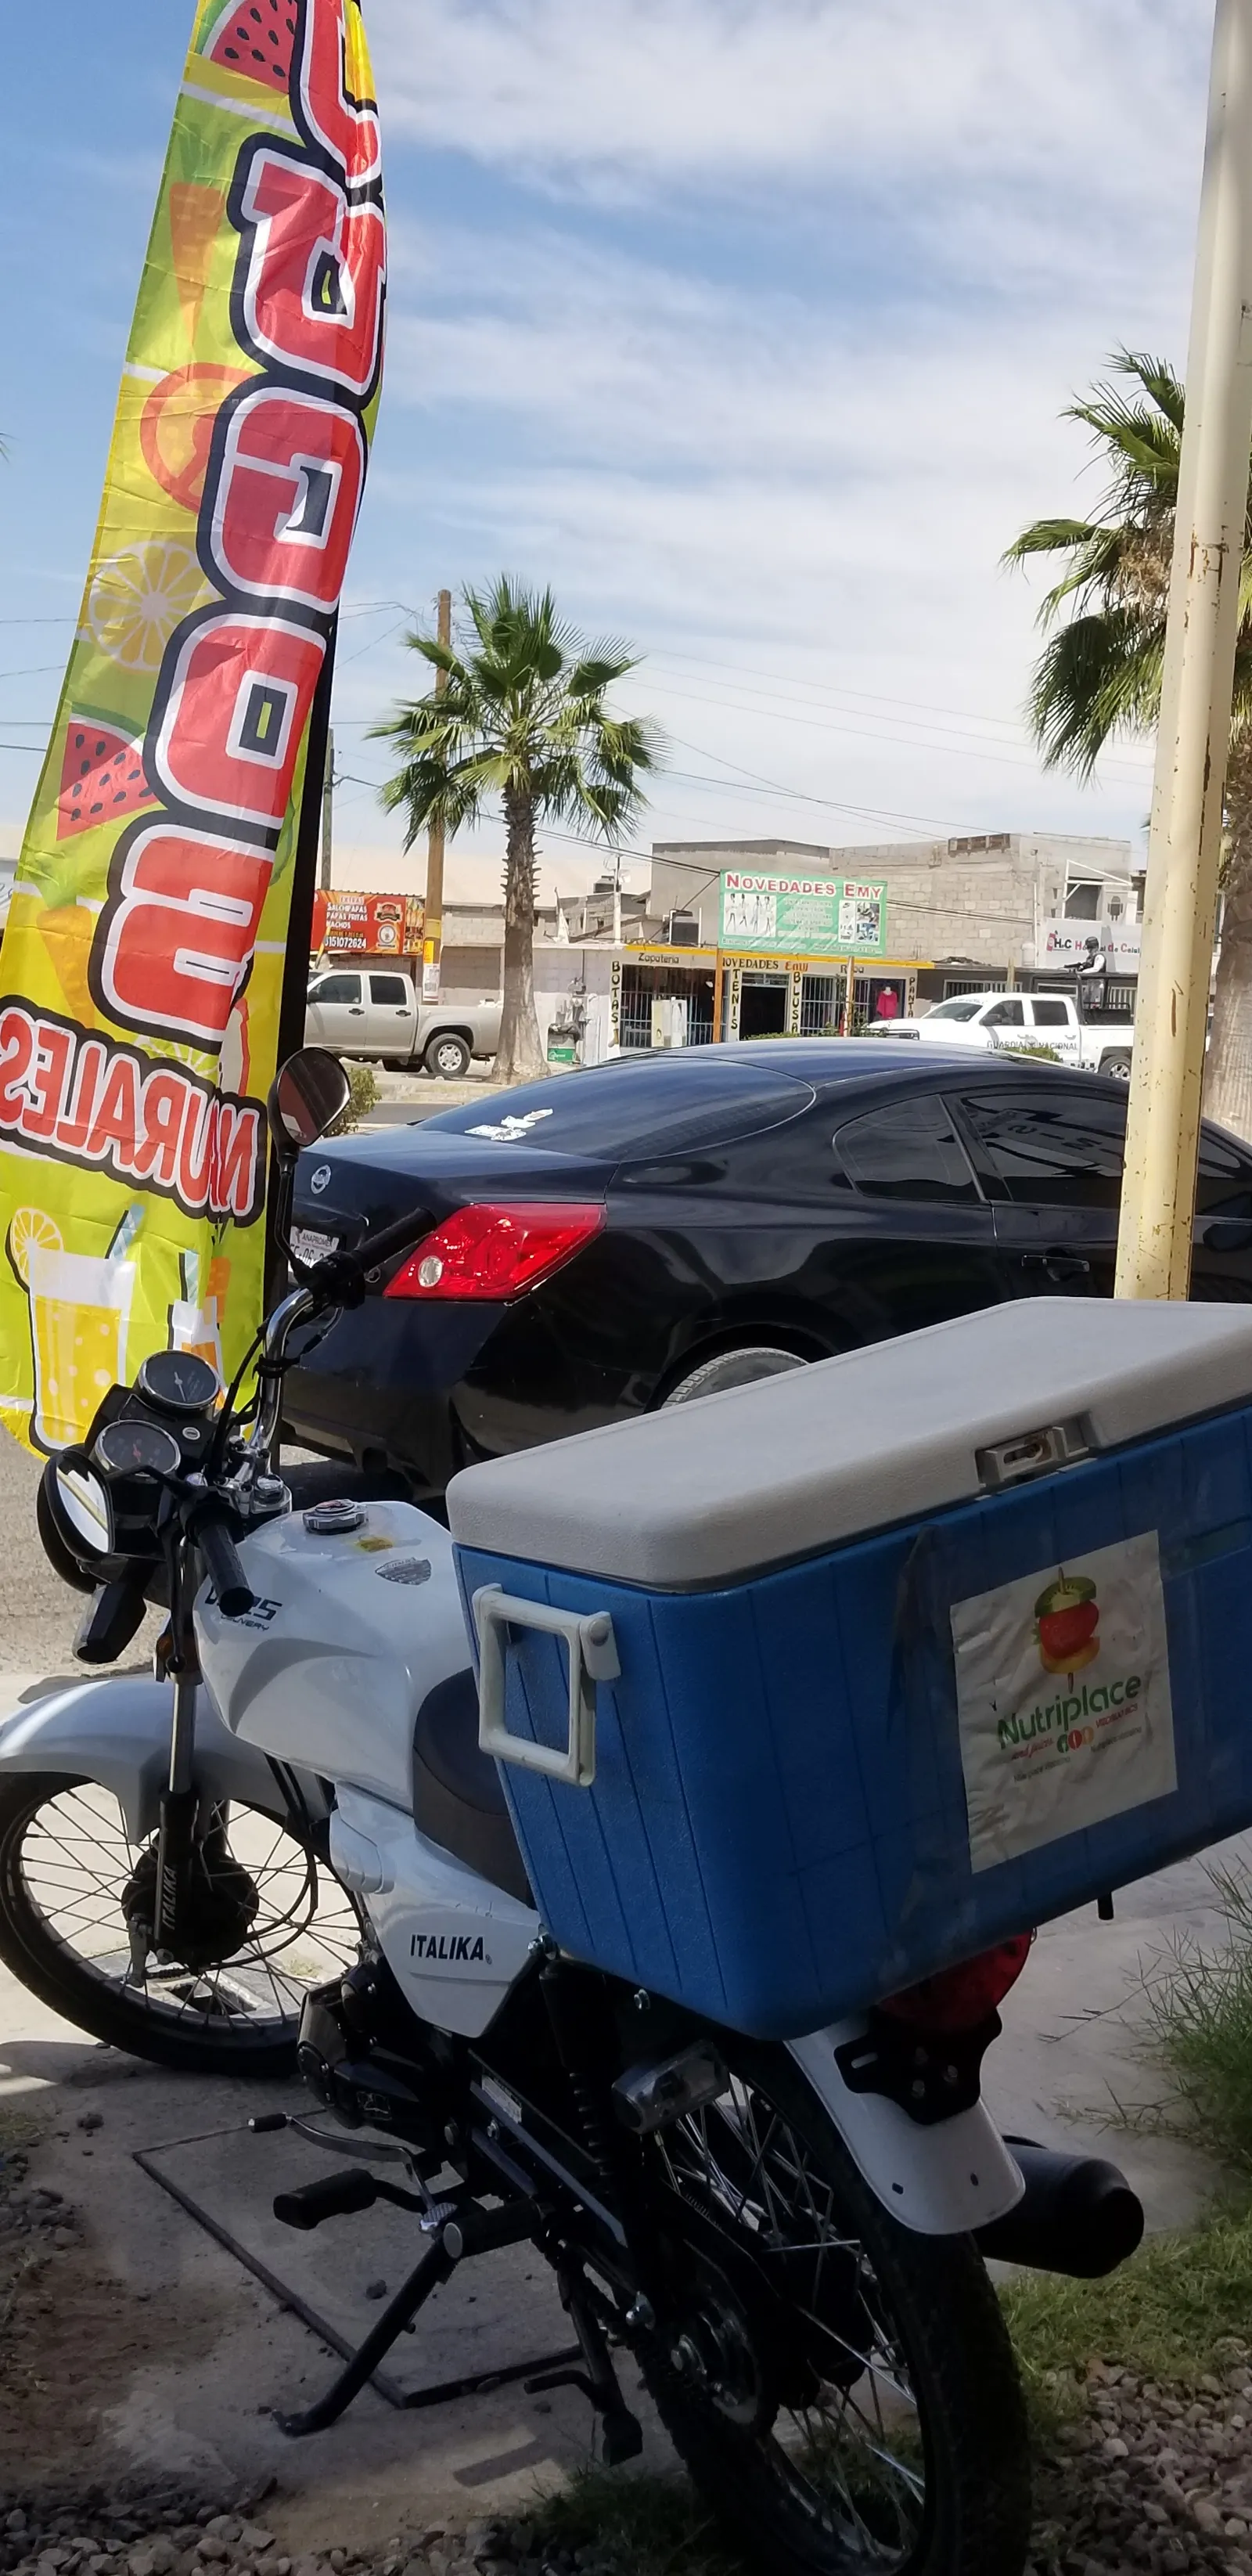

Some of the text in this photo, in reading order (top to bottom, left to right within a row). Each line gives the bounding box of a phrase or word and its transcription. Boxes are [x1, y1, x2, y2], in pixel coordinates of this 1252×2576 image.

[725, 873, 883, 899] NOVEDADES EMY
[1121, 943, 1140, 953] Celul
[840, 964, 864, 974] Ra
[611, 960, 621, 1024] BOTAS
[730, 968, 740, 1030] TENIS
[987, 1039, 1078, 1051] GUARDIA NACIONAL
[998, 1675, 1142, 1750] Nutriplace
[162, 1864, 177, 1931] ITALIKA
[410, 1933, 484, 1961] ITALIKA
